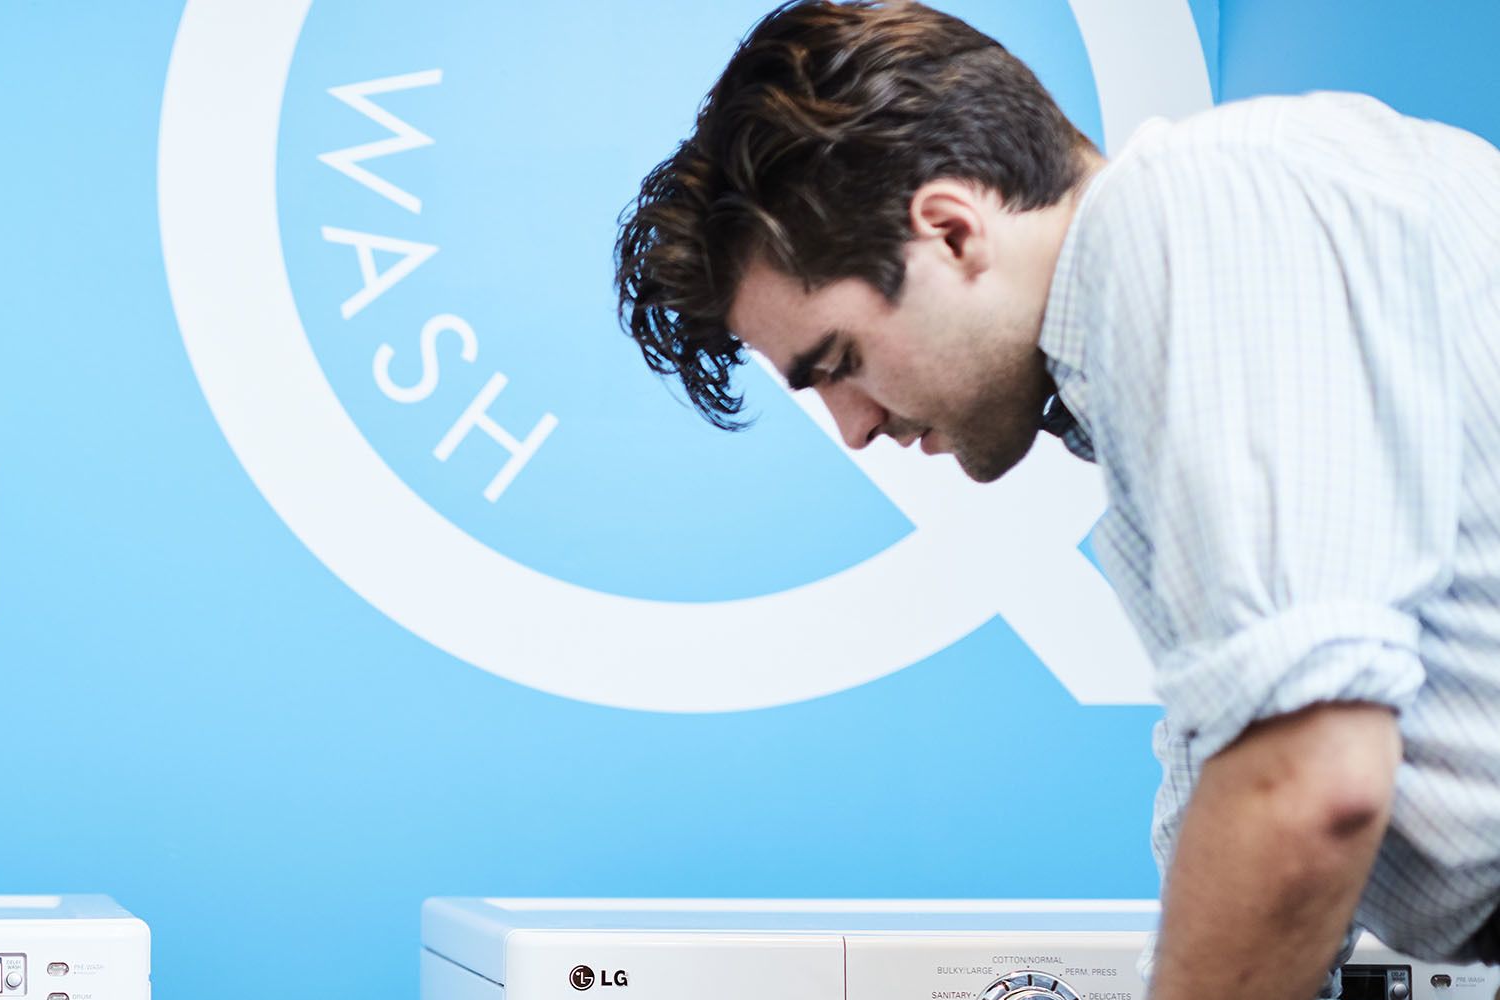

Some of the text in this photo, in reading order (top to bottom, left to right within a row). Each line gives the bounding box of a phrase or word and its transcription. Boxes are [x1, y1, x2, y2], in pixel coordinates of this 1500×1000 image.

[316, 68, 559, 503] WASH
[992, 956, 1064, 965] COTTON/NORMAL
[937, 967, 993, 975] BULKY/LARGE
[1092, 968, 1117, 976] PRESS
[601, 970, 629, 987] LG
[931, 992, 971, 1000] SANITARY
[1089, 993, 1132, 1000] DELICATES
